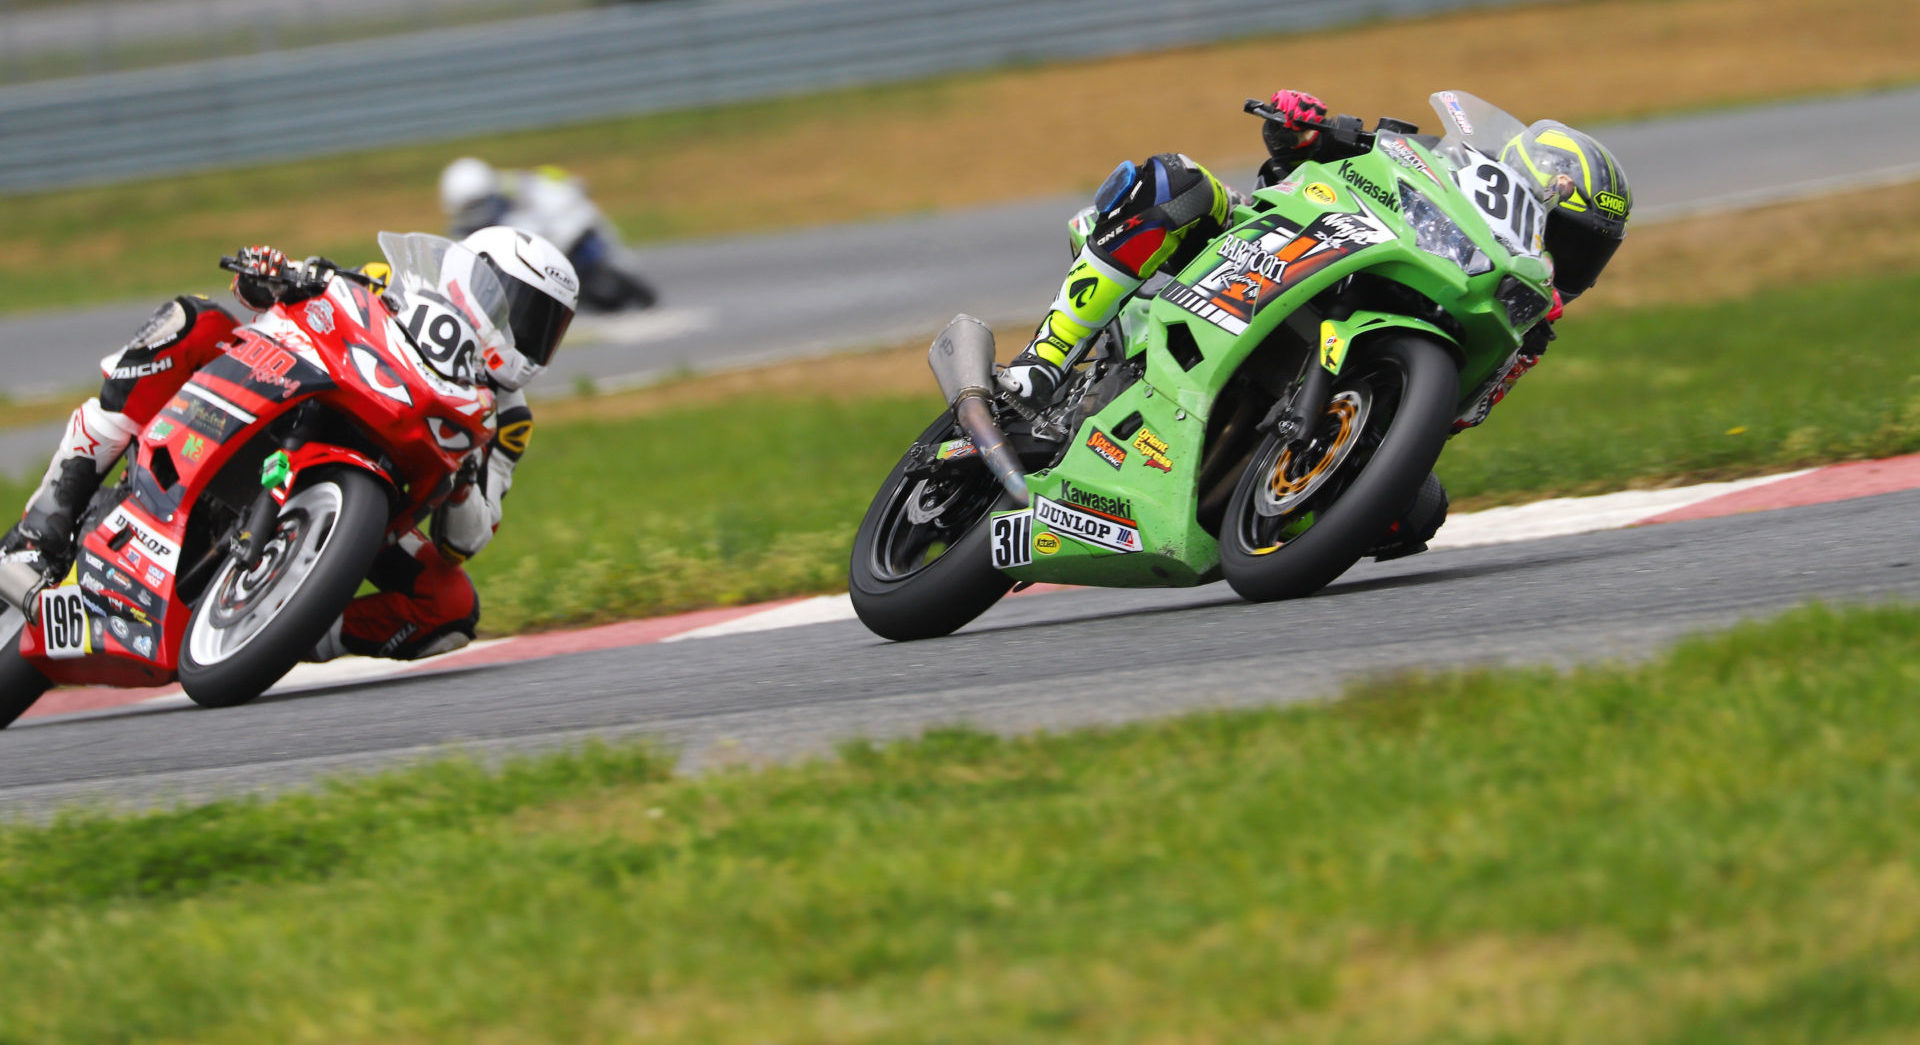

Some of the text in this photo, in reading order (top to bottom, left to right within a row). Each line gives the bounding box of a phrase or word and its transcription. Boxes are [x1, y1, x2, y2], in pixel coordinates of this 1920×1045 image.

[1338, 160, 1401, 213] Kawasaki
[1474, 164, 1536, 253] 311
[1096, 224, 1125, 246] ONE
[1321, 213, 1370, 245] Ninja
[408, 304, 476, 379] 196
[1094, 446, 1122, 467] RACING
[1132, 437, 1173, 468] Express
[1138, 428, 1169, 453] Orient
[1061, 479, 1131, 518] Kawasaki
[1039, 502, 1111, 539] DUNLOP
[994, 515, 1031, 566] 311
[45, 594, 84, 650] 196
